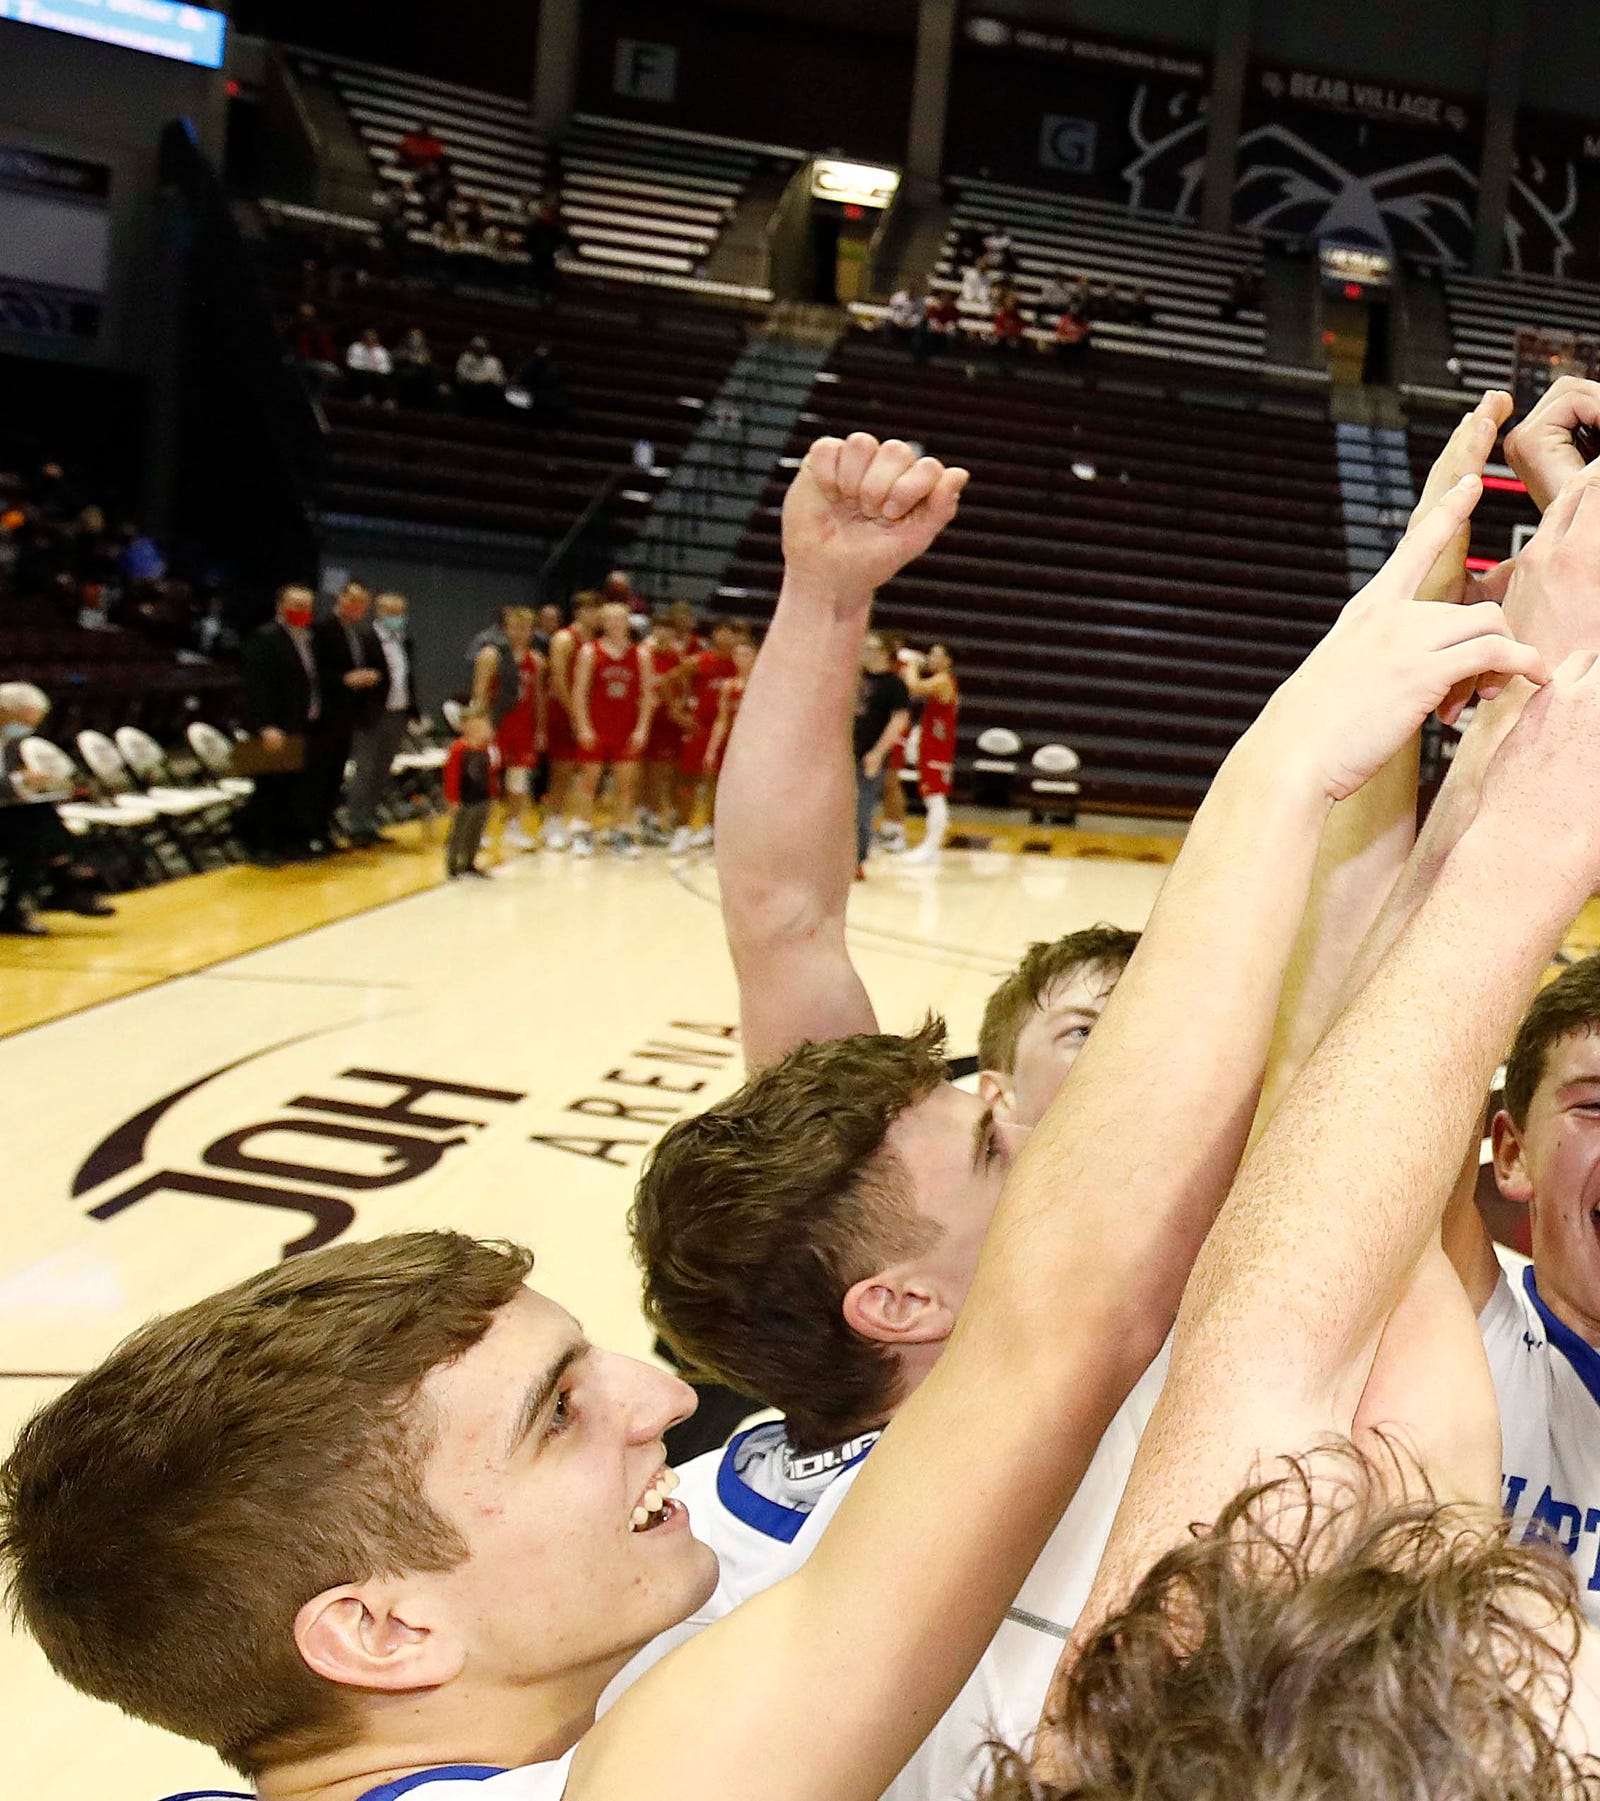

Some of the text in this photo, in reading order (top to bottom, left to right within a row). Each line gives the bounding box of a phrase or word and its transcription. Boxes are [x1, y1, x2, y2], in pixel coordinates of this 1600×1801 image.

[632, 47, 659, 91] F
[1289, 71, 1444, 123] BEAR VILLAGE
[1052, 121, 1090, 166] G
[529, 1020, 739, 1168] ARENA
[86, 1067, 529, 1260] JQH
